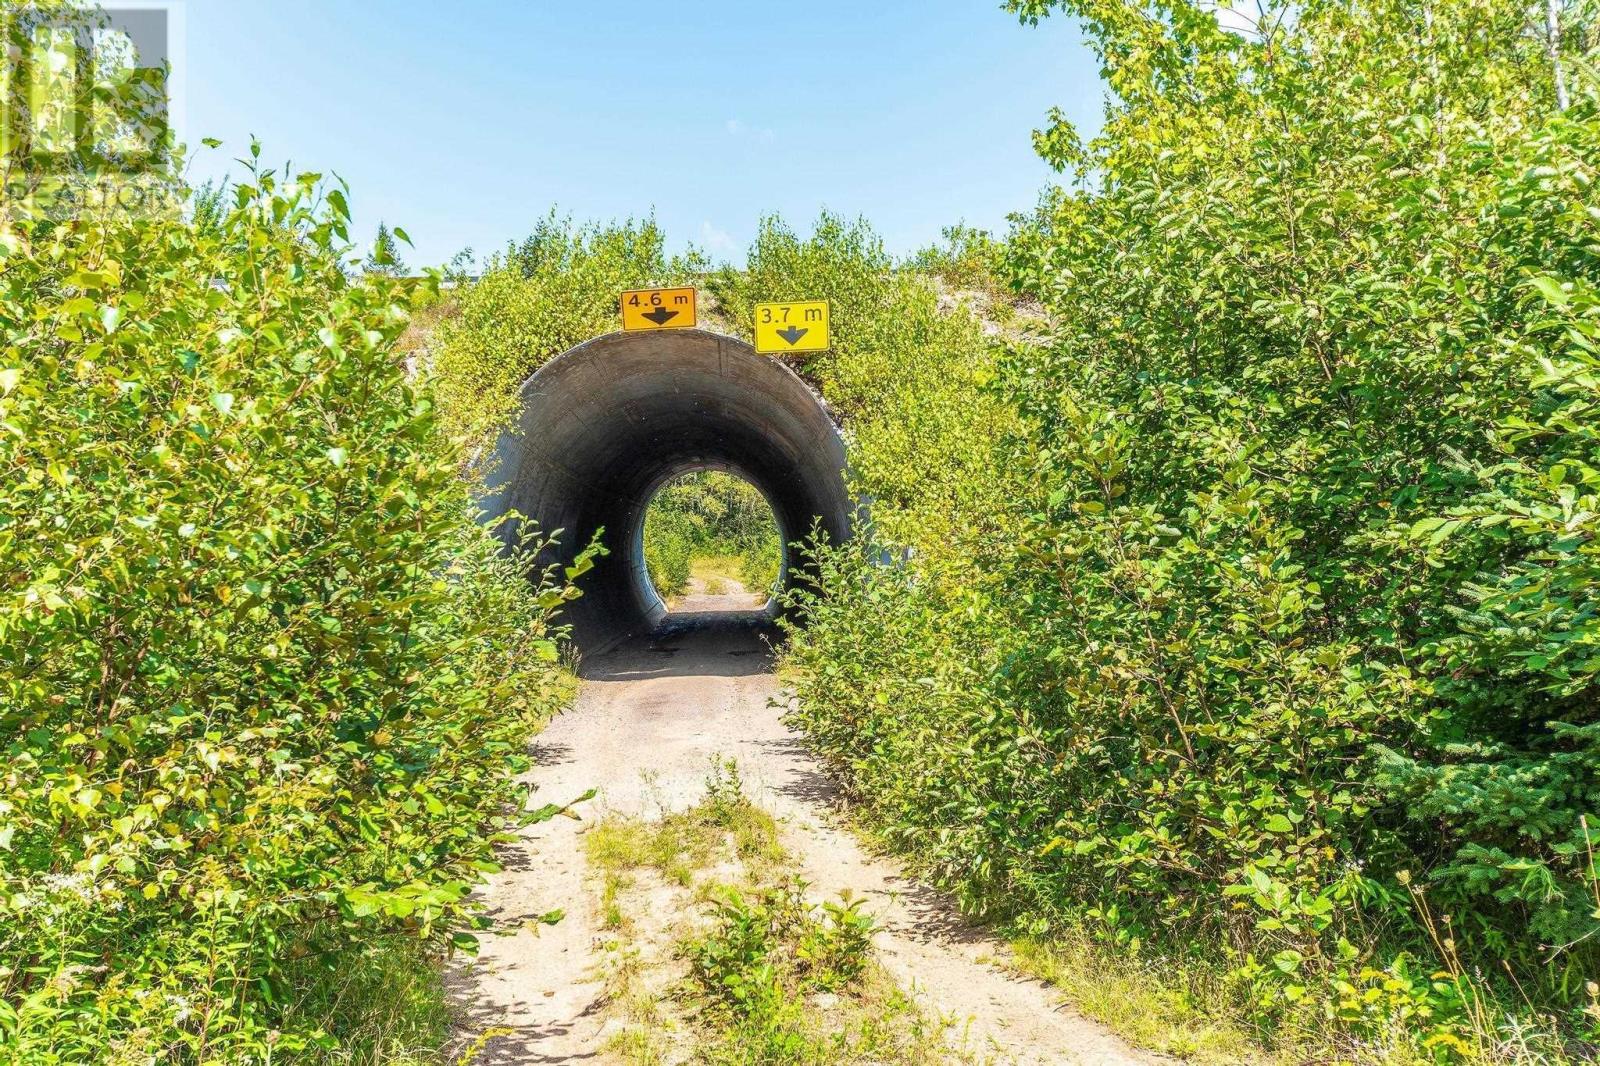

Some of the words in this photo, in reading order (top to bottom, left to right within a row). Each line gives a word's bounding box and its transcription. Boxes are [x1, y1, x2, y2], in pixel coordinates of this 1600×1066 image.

[628, 292, 662, 307] 4.6
[674, 294, 688, 305] m
[761, 307, 791, 323] 3.7
[804, 308, 822, 321] m
